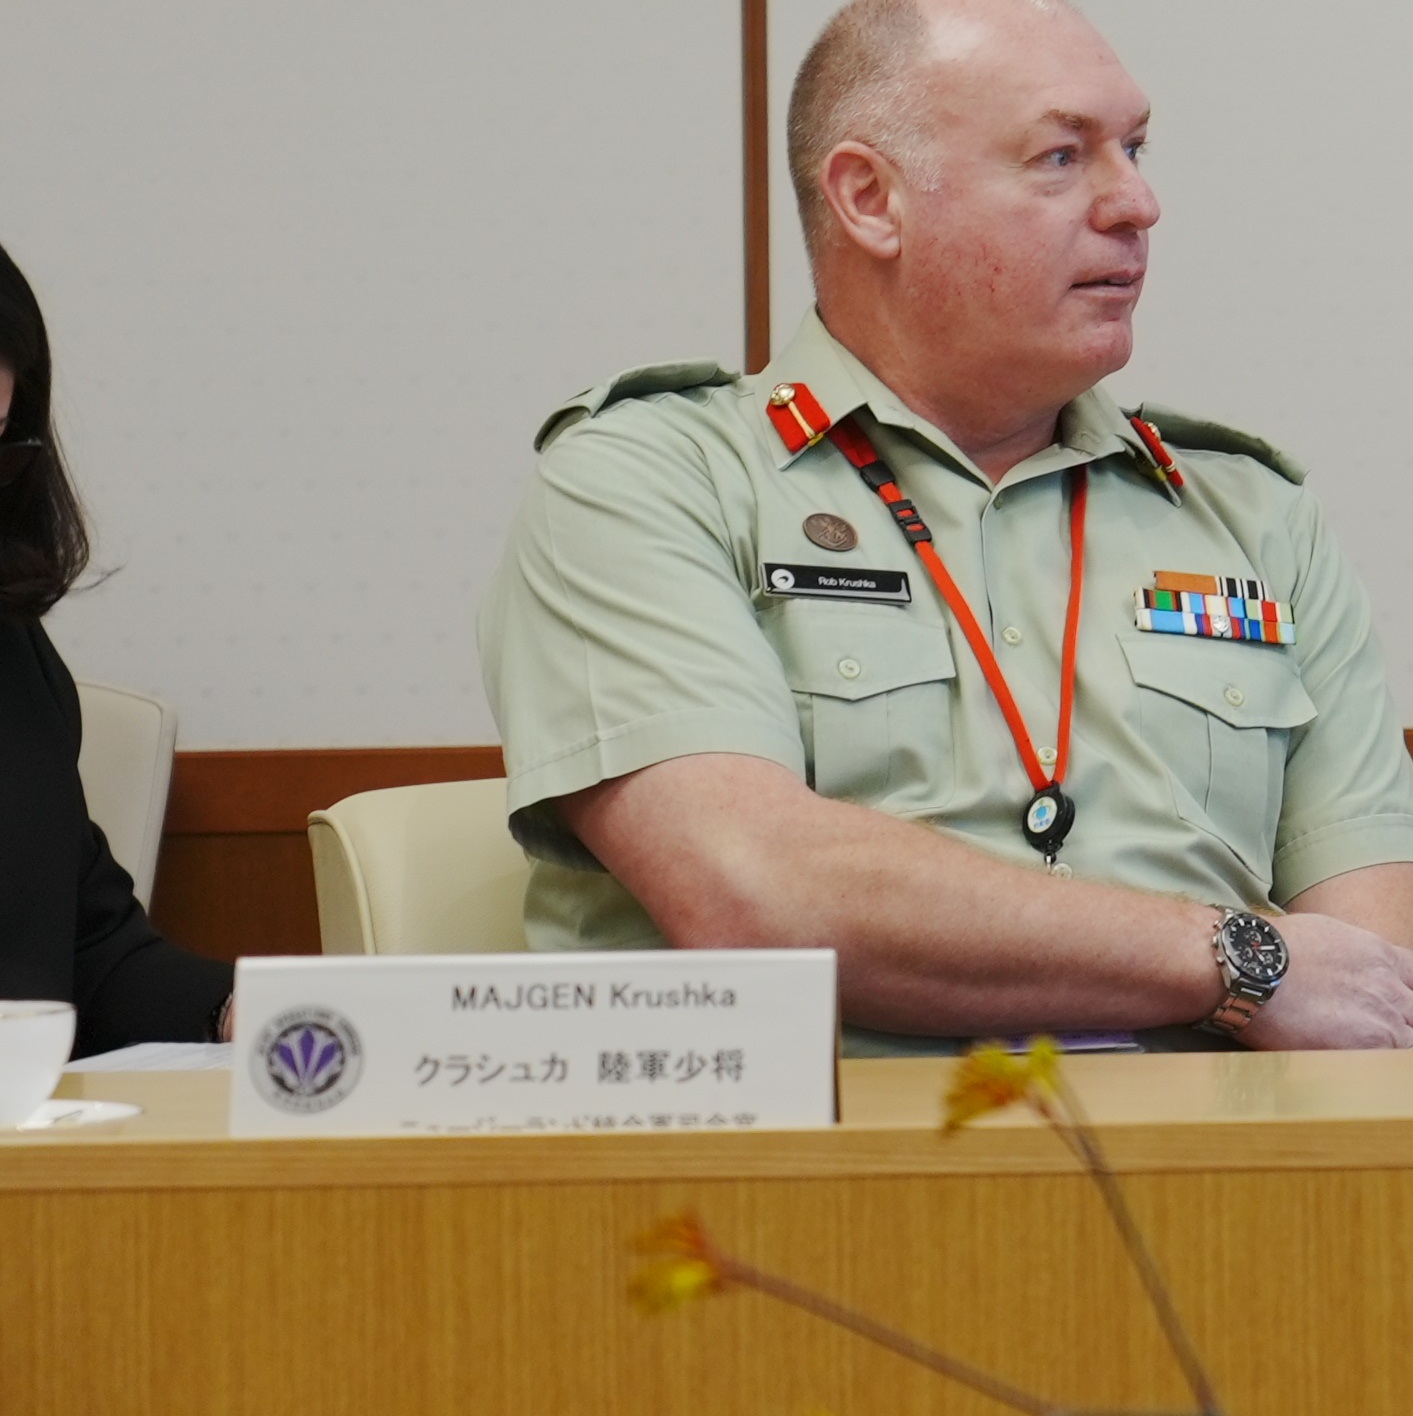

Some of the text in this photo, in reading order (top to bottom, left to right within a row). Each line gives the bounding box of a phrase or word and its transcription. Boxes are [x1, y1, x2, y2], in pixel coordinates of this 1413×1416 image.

[818, 576, 876, 588] Rob Krushka
[451, 983, 737, 1011] MAJGEN Krushka
[414, 1047, 745, 1087] クラシュカ 陸軍少将
